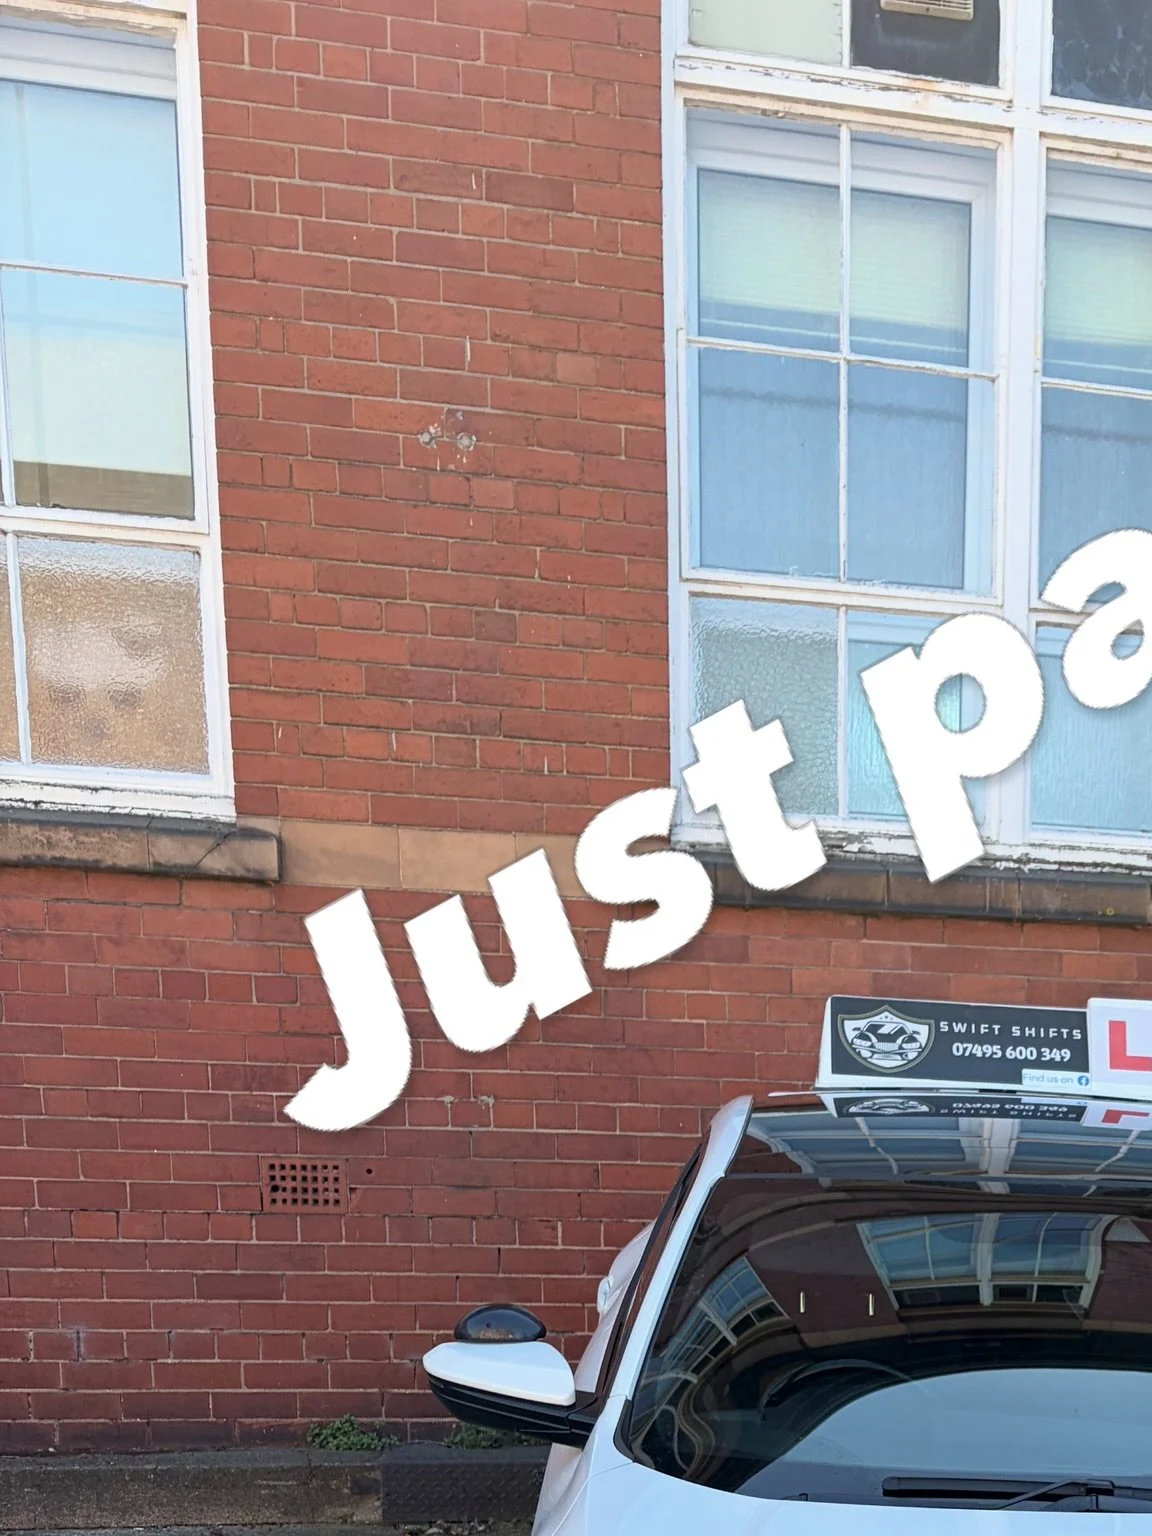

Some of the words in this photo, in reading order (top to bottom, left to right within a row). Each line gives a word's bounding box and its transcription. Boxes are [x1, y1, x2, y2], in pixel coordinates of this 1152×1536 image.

[940, 1021, 1001, 1036] SWIFT
[1011, 1025, 1083, 1040] SHIFTS
[952, 1042, 1002, 1059] 07495
[1005, 1045, 1037, 1060] 600
[1041, 1047, 1072, 1062] 349
[1023, 1072, 1045, 1082] Find
[1047, 1075, 1059, 1083] us
[1060, 1076, 1074, 1084] on
